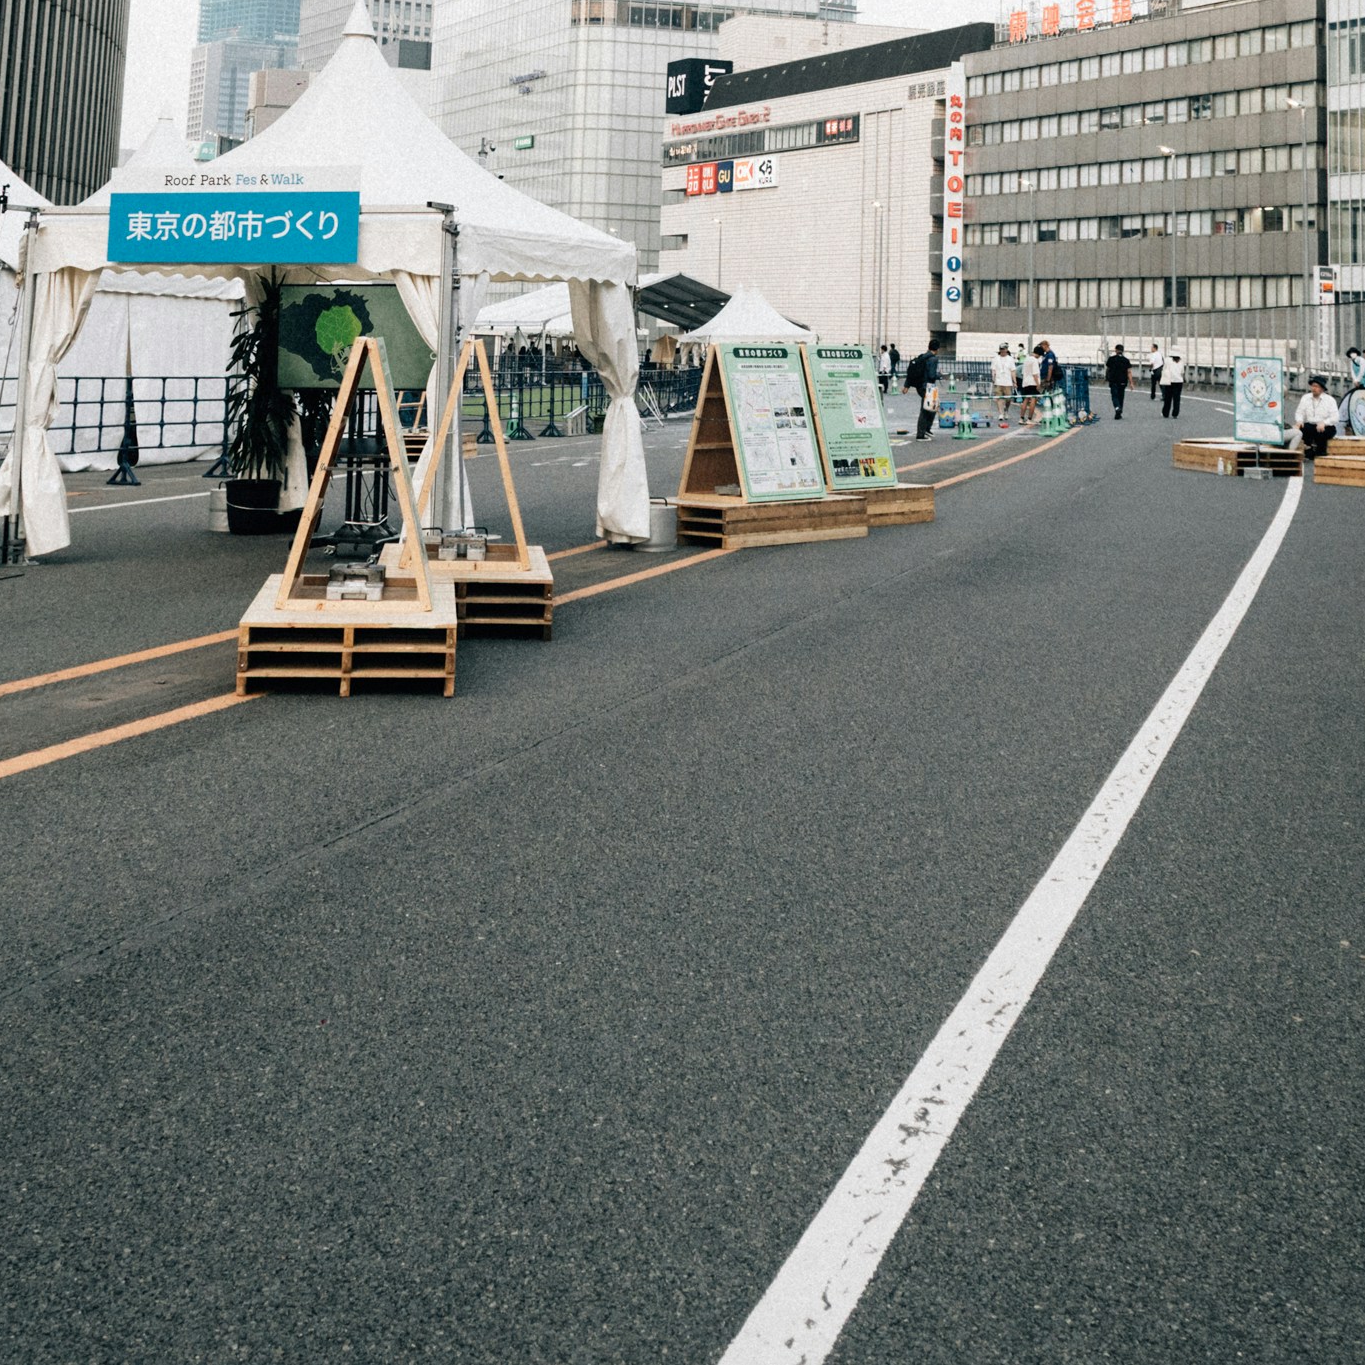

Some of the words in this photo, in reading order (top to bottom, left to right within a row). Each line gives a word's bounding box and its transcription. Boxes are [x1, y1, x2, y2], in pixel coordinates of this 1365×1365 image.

[668, 73, 687, 98] PLST
[949, 93, 963, 141] 丸の内
[164, 174, 197, 186] Roof
[200, 173, 232, 186] Park
[235, 173, 257, 185] Fes
[260, 174, 269, 185] &
[270, 173, 304, 185] Walk
[718, 169, 731, 184] GU
[947, 149, 963, 245] TOEI
[125, 209, 340, 242] 東京の都市づくり
